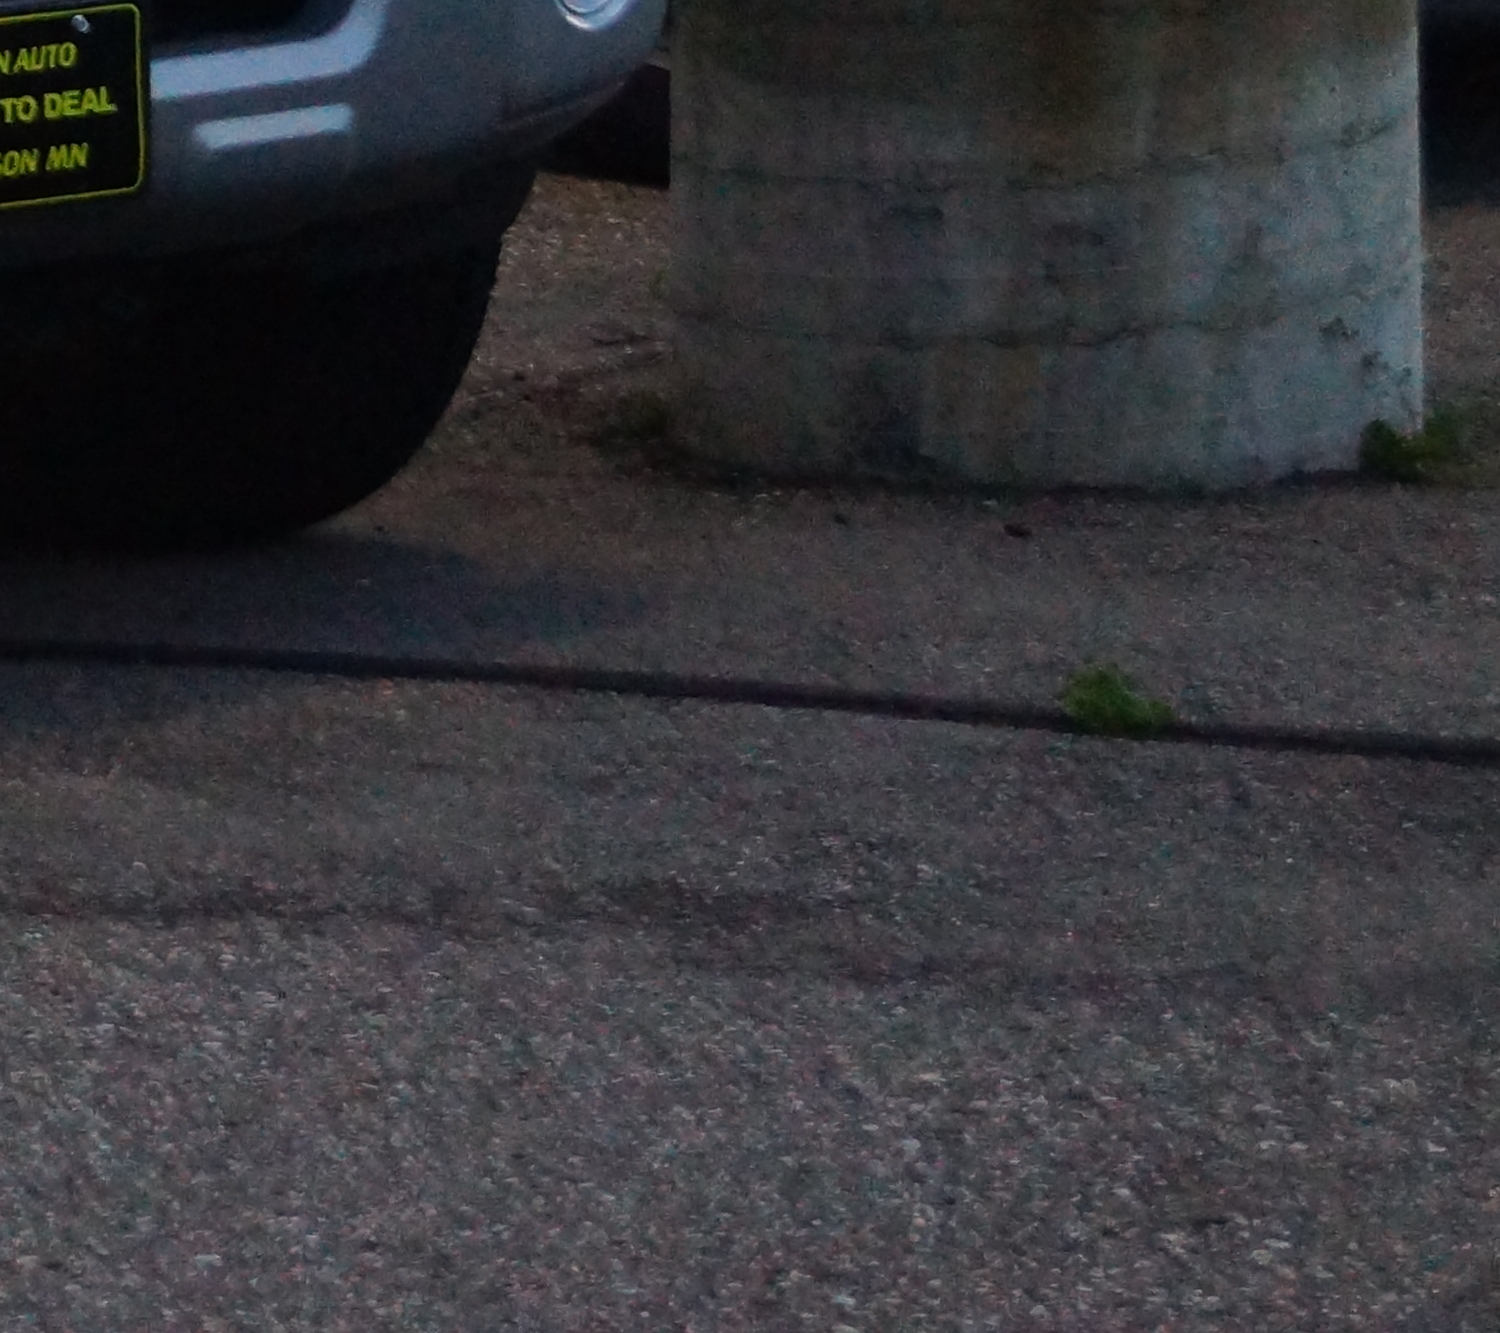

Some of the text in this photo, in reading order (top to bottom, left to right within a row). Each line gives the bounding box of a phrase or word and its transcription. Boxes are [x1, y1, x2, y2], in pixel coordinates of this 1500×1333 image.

[14, 40, 79, 77] AUTO
[42, 84, 120, 118] DEAL
[45, 141, 90, 172] MN
